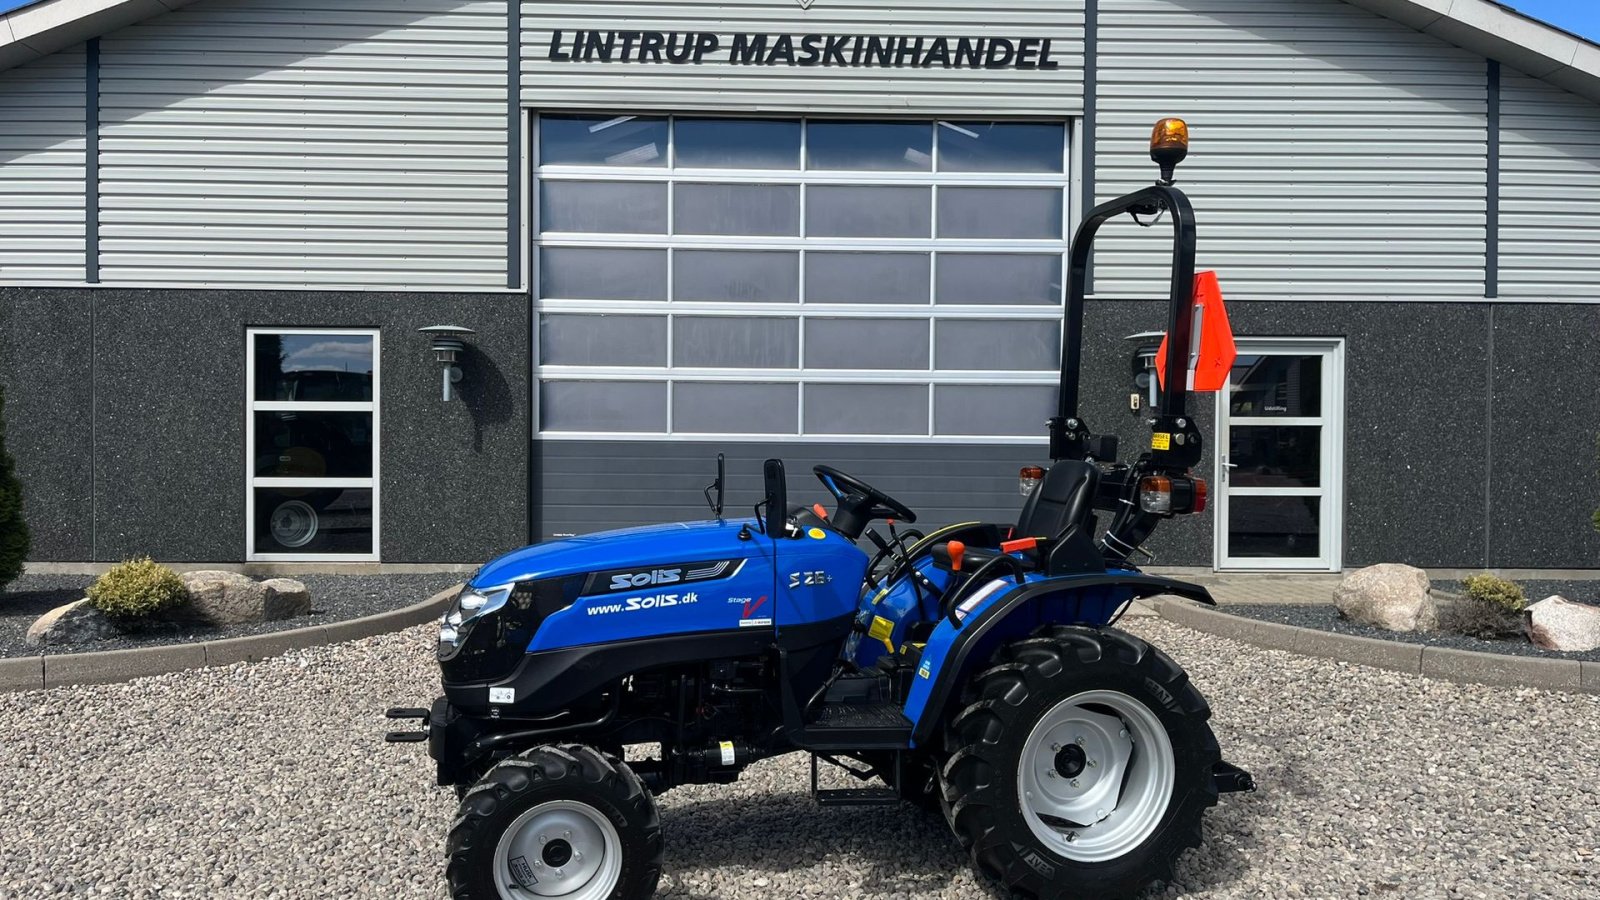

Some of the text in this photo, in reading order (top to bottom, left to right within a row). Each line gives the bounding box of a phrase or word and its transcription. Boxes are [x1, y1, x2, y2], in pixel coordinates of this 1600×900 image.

[549, 30, 1058, 70] LINTRUP MASKINHANDEL
[789, 572, 800, 588] S
[743, 595, 768, 619] V
